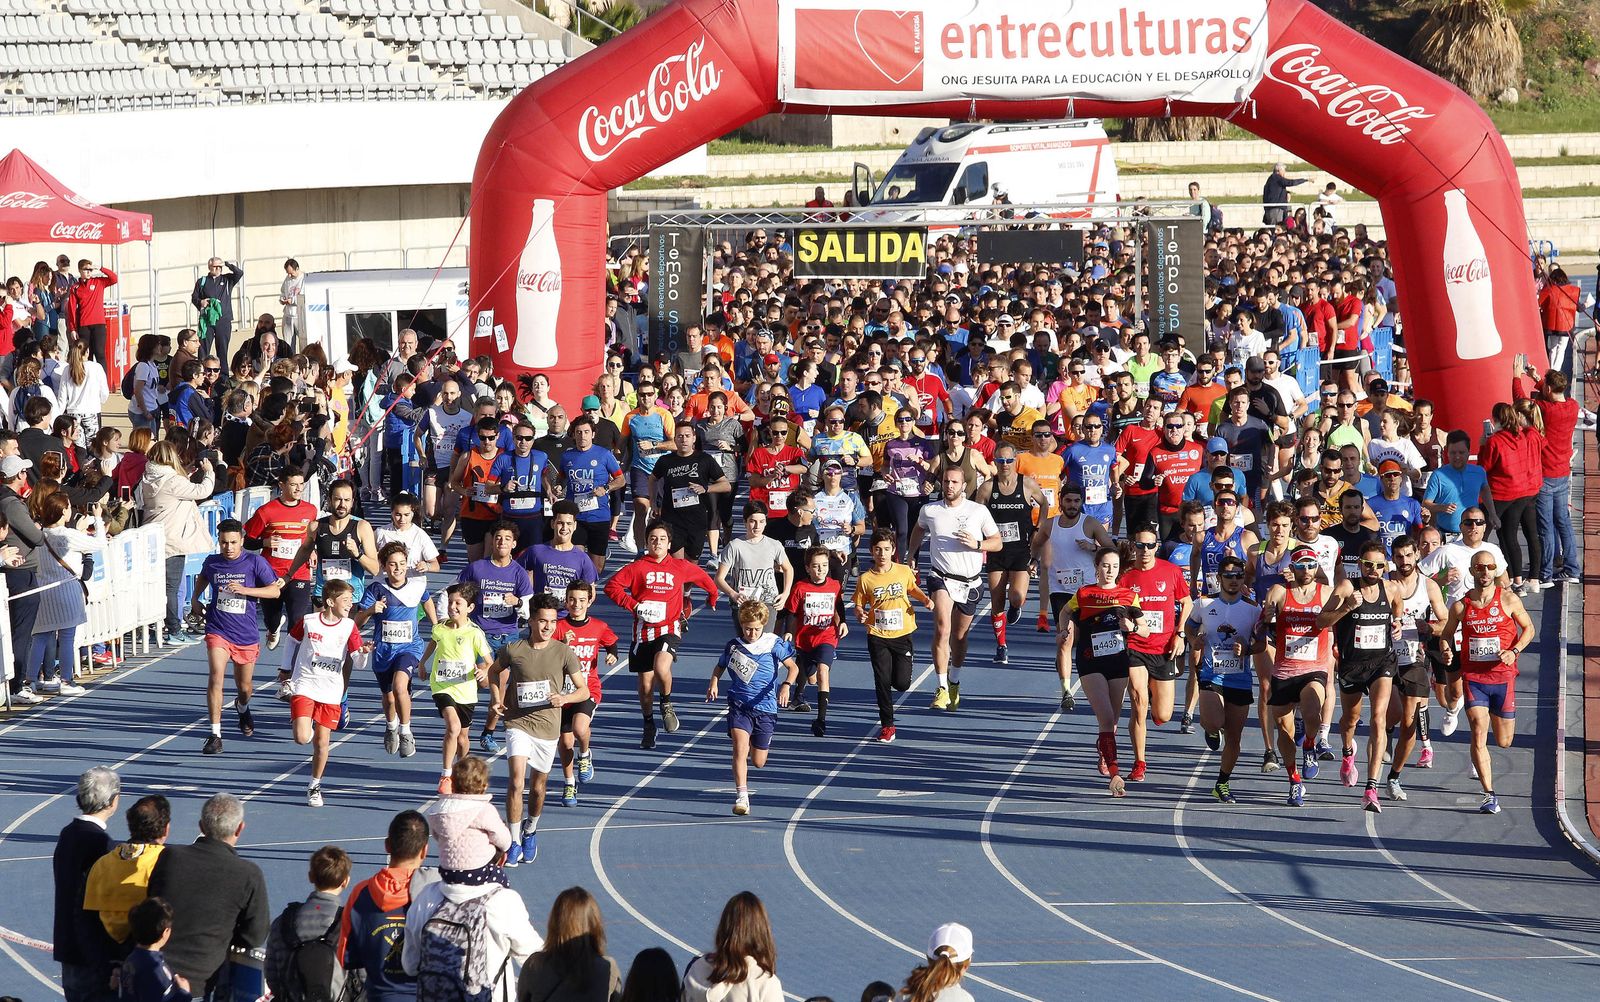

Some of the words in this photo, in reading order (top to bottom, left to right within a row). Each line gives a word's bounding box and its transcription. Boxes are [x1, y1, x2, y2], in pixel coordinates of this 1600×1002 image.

[940, 8, 1252, 59] entreculturas
[941, 75, 968, 85] ONG
[971, 74, 1018, 85] JESUITA
[1021, 74, 1051, 85] PARA
[1054, 74, 1069, 84] LA
[1072, 70, 1140, 84] EDUCACIÓN
[1146, 72, 1153, 82] Y
[1157, 72, 1171, 82] EL
[1174, 69, 1251, 81] DESARROLLO
[578, 34, 723, 162] Coca-Cola
[1264, 43, 1436, 145] Coca-Cola
[50, 221, 104, 240] Coca-Cola
[798, 230, 925, 263] SALIDA
[1157, 227, 1165, 270] deportivos
[657, 234, 666, 278] deportivos
[1165, 225, 1180, 294] Tempo
[666, 232, 681, 300] Tempo
[1157, 304, 1164, 315] de
[657, 310, 665, 321] de
[569, 469, 594, 480] RCM
[1082, 464, 1107, 475] RCM
[579, 499, 592, 508] 360
[280, 546, 294, 555] 351
[1207, 552, 1221, 565] RC
[558, 565, 577, 573] Silvestre
[496, 580, 516, 588] Silvestre
[646, 571, 675, 587] SEK
[1064, 576, 1078, 584] 218
[873, 582, 903, 597] 子供
[222, 599, 240, 608] 4505
[811, 601, 829, 609] 4450
[880, 617, 898, 626] 4143
[388, 629, 407, 638] 4401
[1364, 635, 1379, 643] 178
[1099, 639, 1117, 650] 4439
[1474, 647, 1494, 656] 4508
[317, 661, 336, 672] 4263
[1220, 659, 1239, 667] 4287
[442, 668, 462, 678] 4264
[522, 691, 545, 701] 4343
